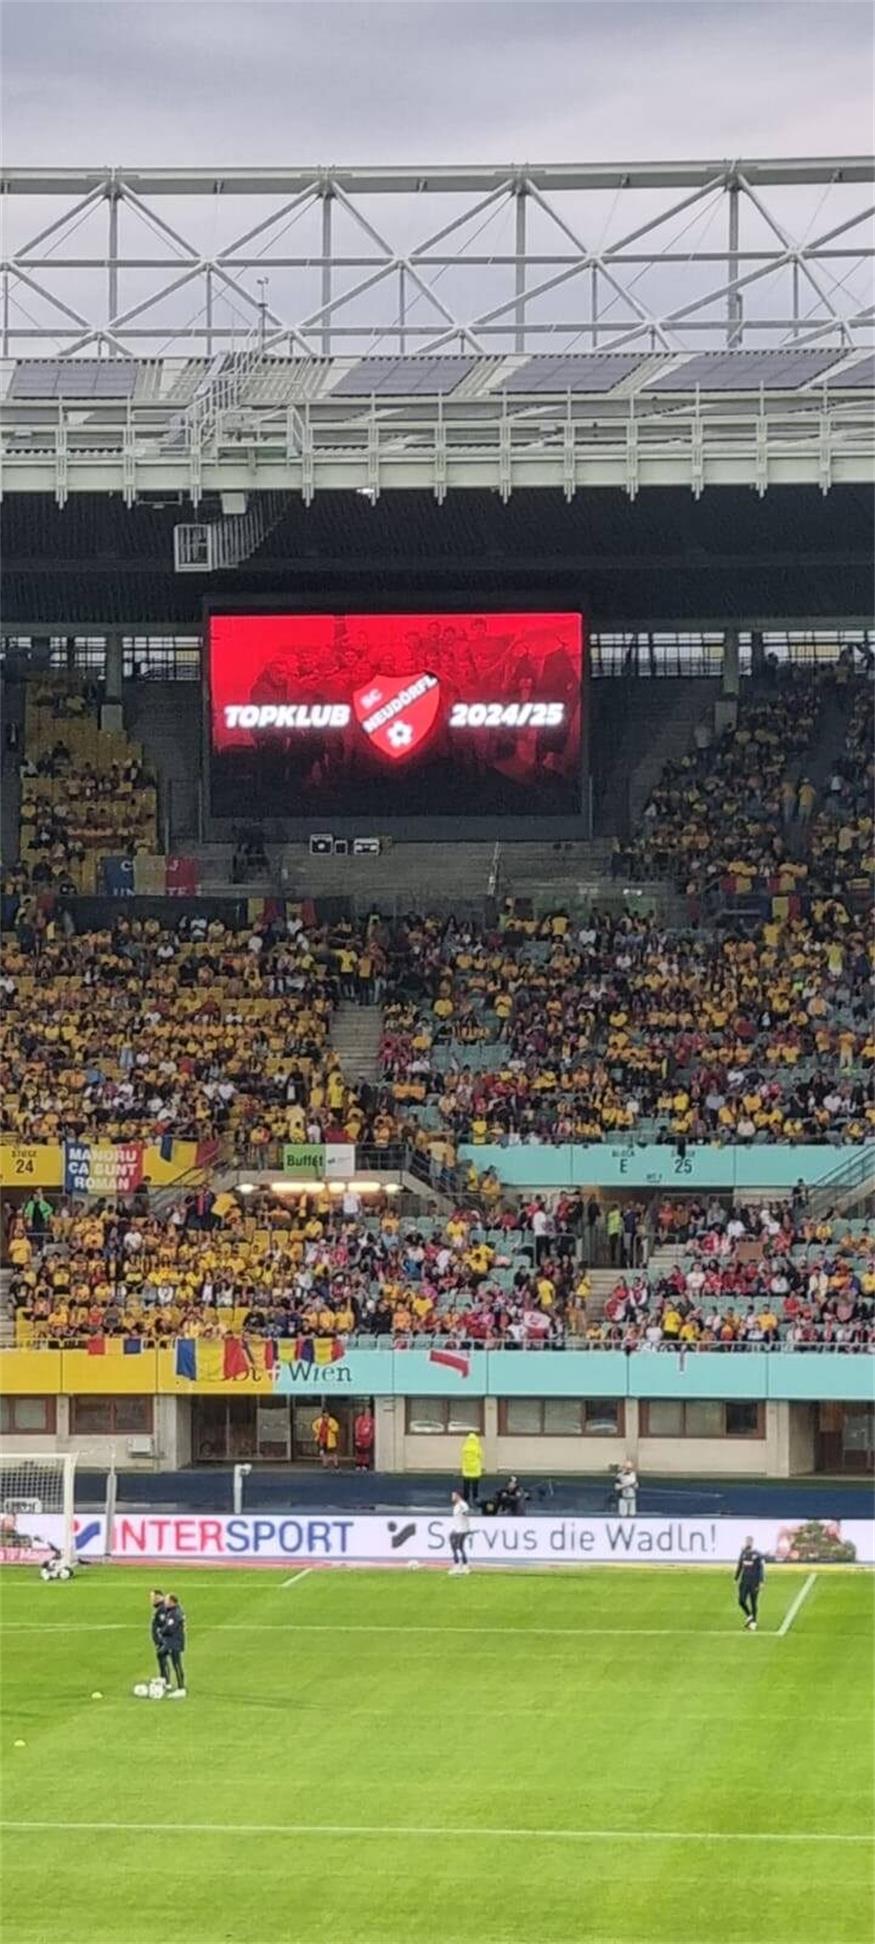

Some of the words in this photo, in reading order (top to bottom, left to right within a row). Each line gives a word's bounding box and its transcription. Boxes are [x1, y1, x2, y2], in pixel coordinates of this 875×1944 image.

[224, 704, 351, 728] TOPKLUB
[450, 703, 565, 727] 2024/25
[16, 1159, 34, 1173] 24
[620, 1159, 628, 1173] E
[675, 1159, 692, 1174] 25
[289, 1361, 352, 1382] Wien
[112, 1519, 354, 1553] INTERSPORT
[550, 1523, 595, 1551] die
[605, 1523, 717, 1552] Wadln!
